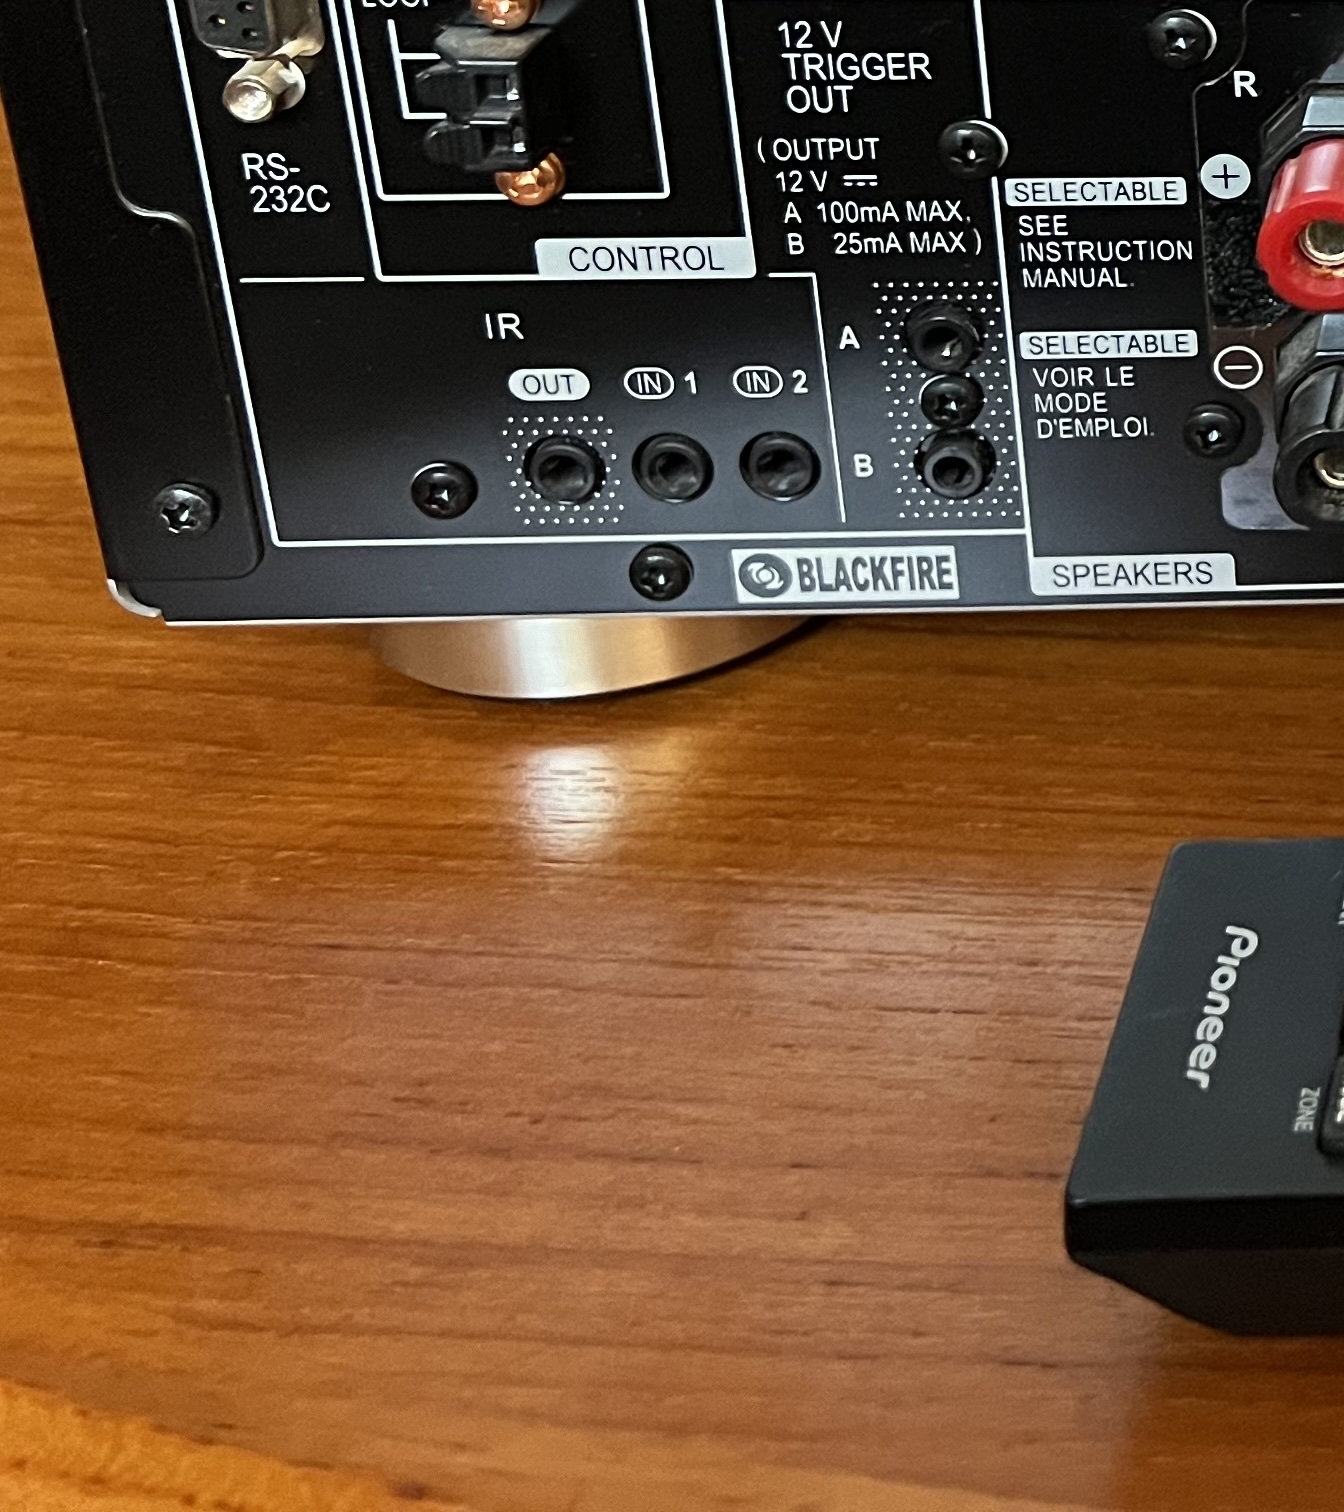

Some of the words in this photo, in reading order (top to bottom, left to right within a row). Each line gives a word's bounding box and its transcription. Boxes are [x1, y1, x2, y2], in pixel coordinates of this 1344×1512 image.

[781, 53, 932, 80] TRIGGER
[1015, 181, 1178, 202] SELECTABLE
[1019, 215, 1068, 236] SEE
[569, 246, 724, 271] CONTROL
[1021, 240, 1192, 262] INSTRUCTION
[1022, 267, 1134, 288] MANUAL.
[486, 313, 524, 339] IR
[1029, 334, 1189, 355] SELECTABLE
[1035, 392, 1107, 413] MODE
[1038, 418, 1154, 438] D'EMPLOI.
[797, 555, 953, 592] BLACKFIRE
[1053, 561, 1212, 587] SPEAKERS
[1187, 926, 1258, 1088] Pioneer
